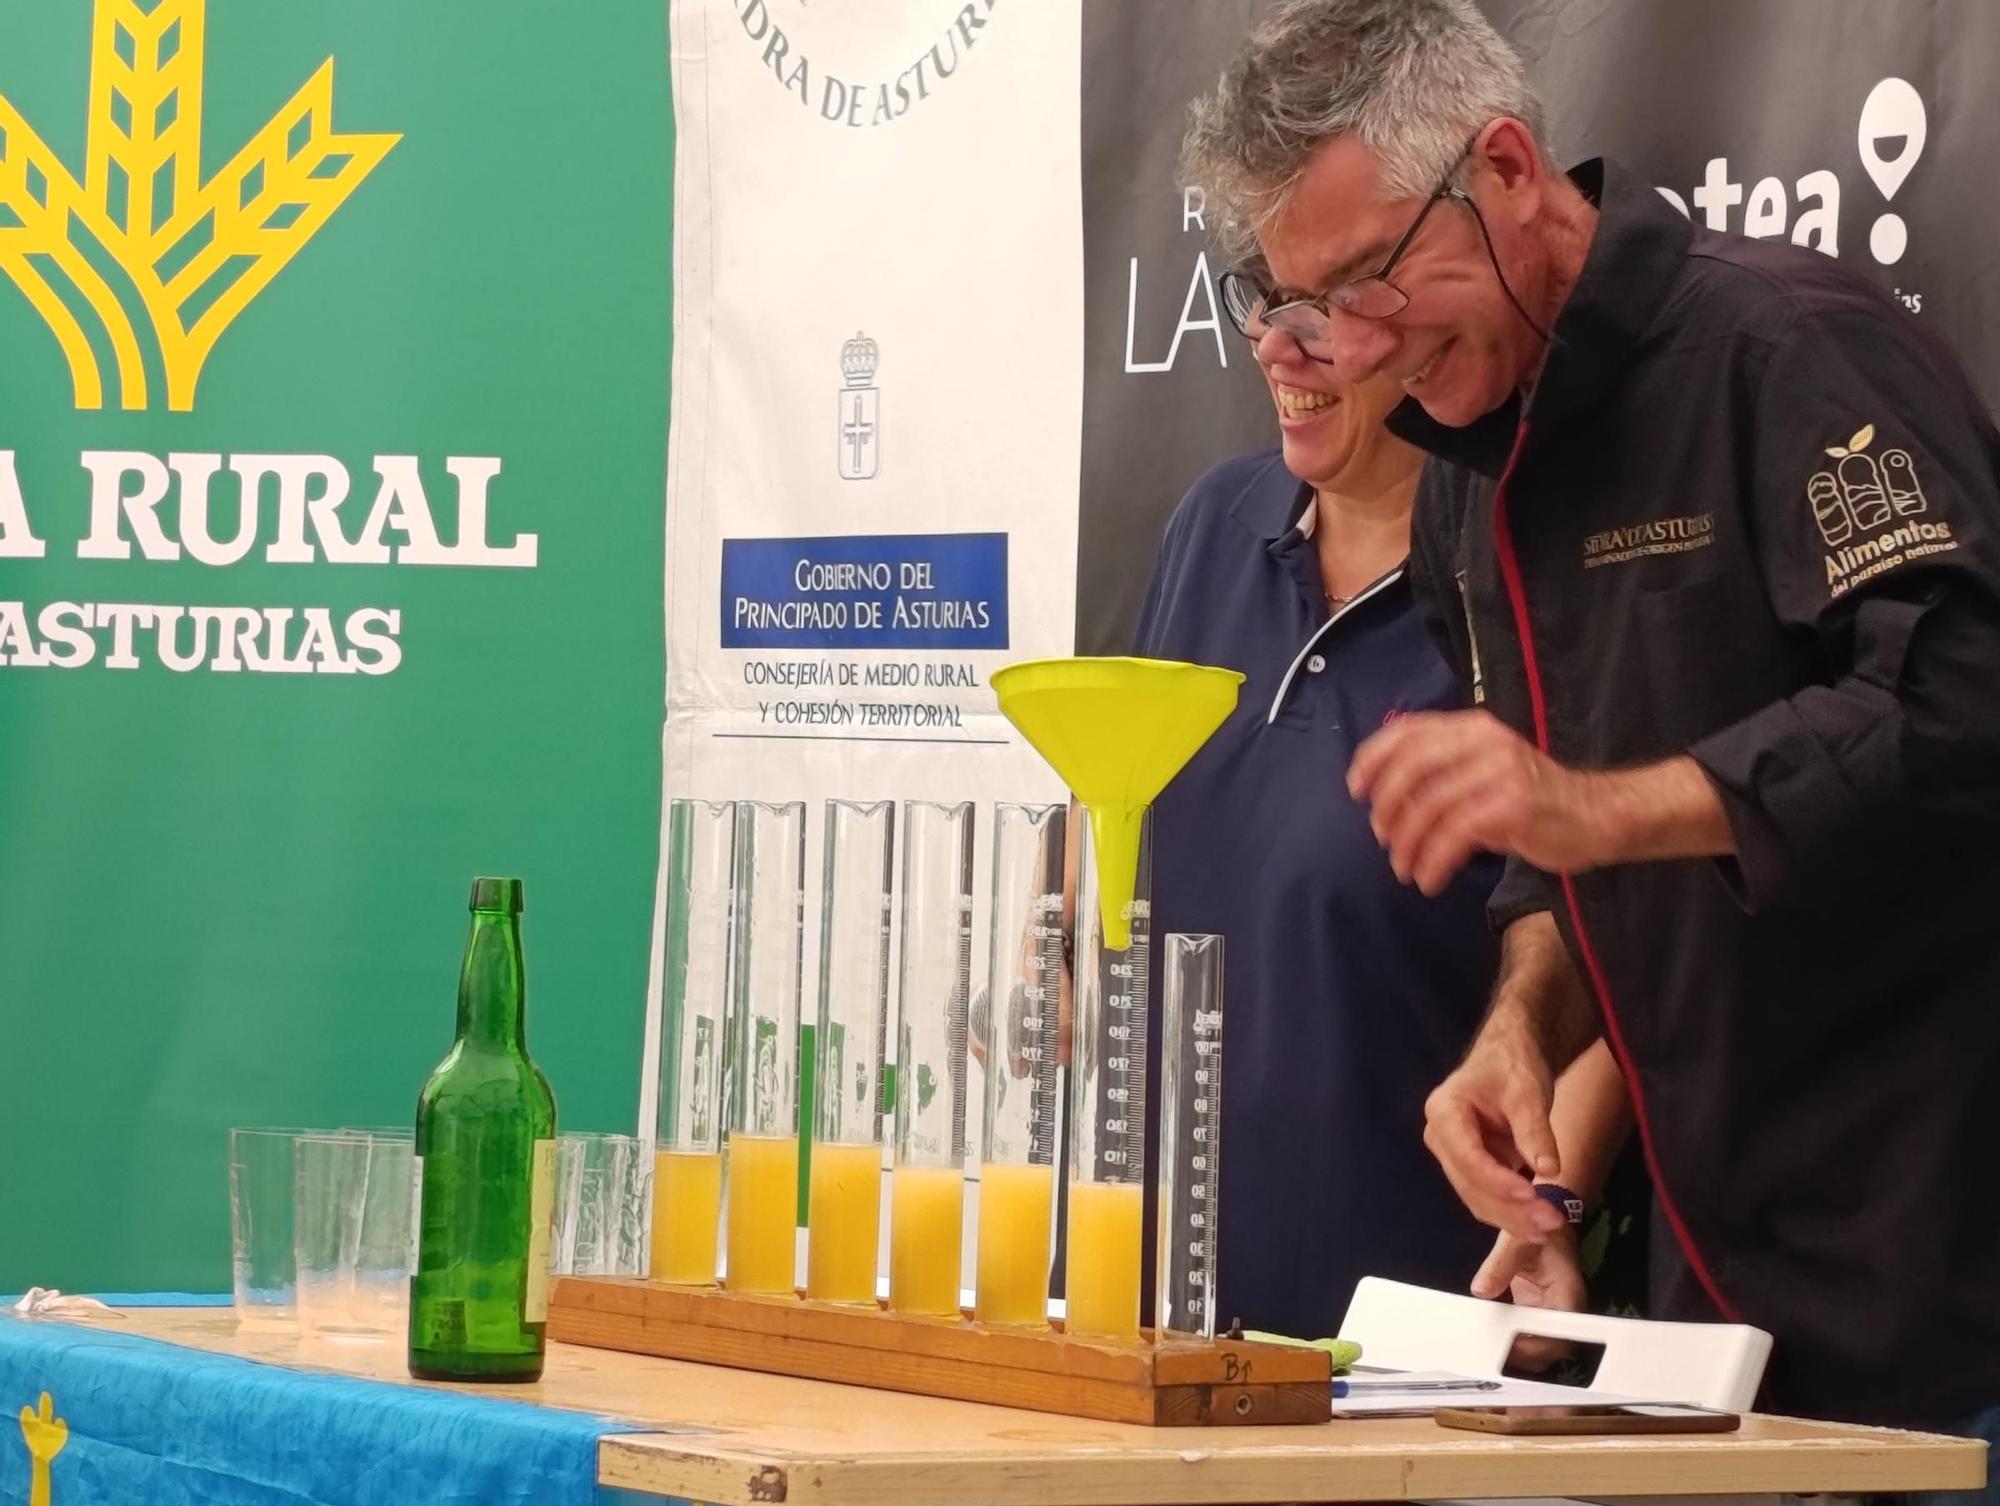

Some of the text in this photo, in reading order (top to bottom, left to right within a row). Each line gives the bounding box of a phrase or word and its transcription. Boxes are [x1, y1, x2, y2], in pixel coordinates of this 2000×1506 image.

[734, 0, 996, 127] DRA DE ASTUR
[77, 450, 538, 567] RURAL
[795, 559, 934, 591] GOBIERNO DEL
[1825, 520, 1951, 585] Alimentos
[735, 596, 989, 629] PRINCIPADO DE ASTURIAS
[0, 601, 402, 675] ASTURIAS
[744, 660, 979, 690] CONSEJERÍA DE MEDIO RURAL
[759, 698, 962, 727] Y COHESIÓN TERRITORIAL
